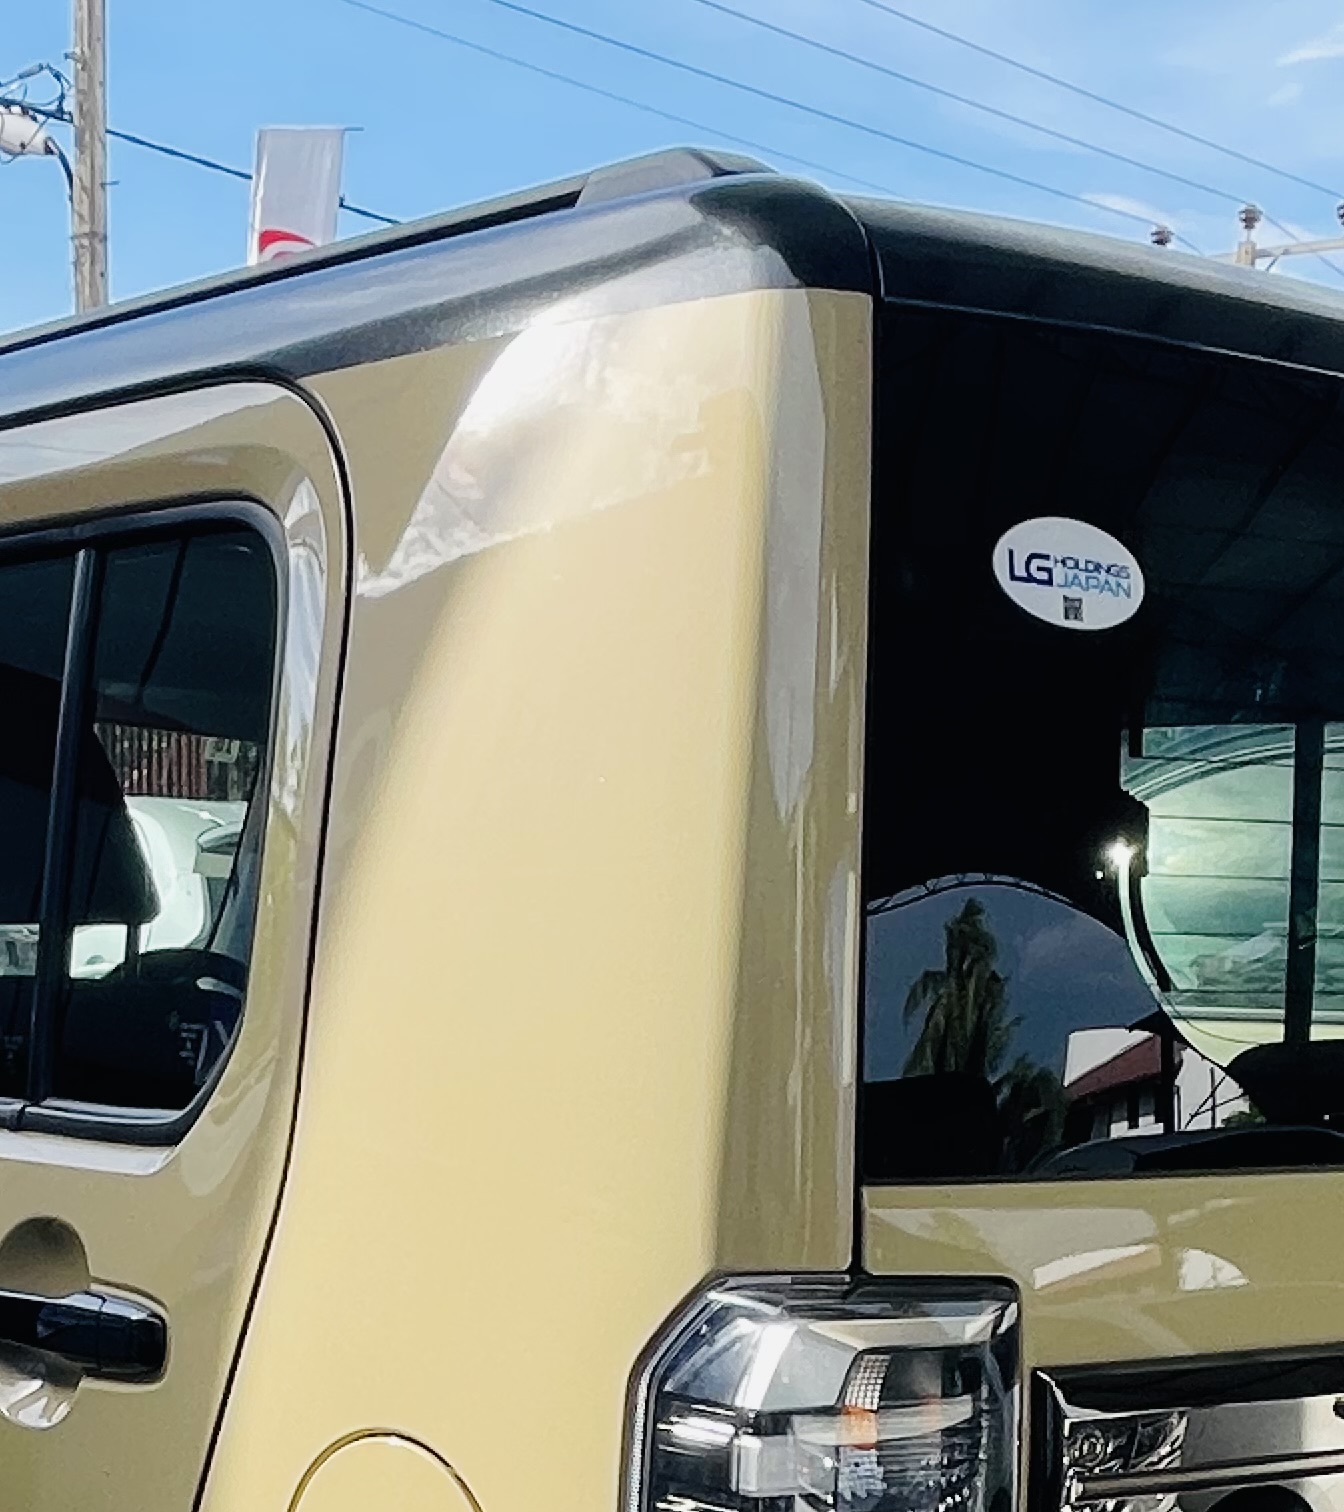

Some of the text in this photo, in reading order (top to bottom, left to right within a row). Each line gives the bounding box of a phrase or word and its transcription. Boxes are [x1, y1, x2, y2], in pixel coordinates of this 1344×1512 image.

[1008, 548, 1131, 587] LG HOLDINGS
[1057, 573, 1132, 599] JAPAN
